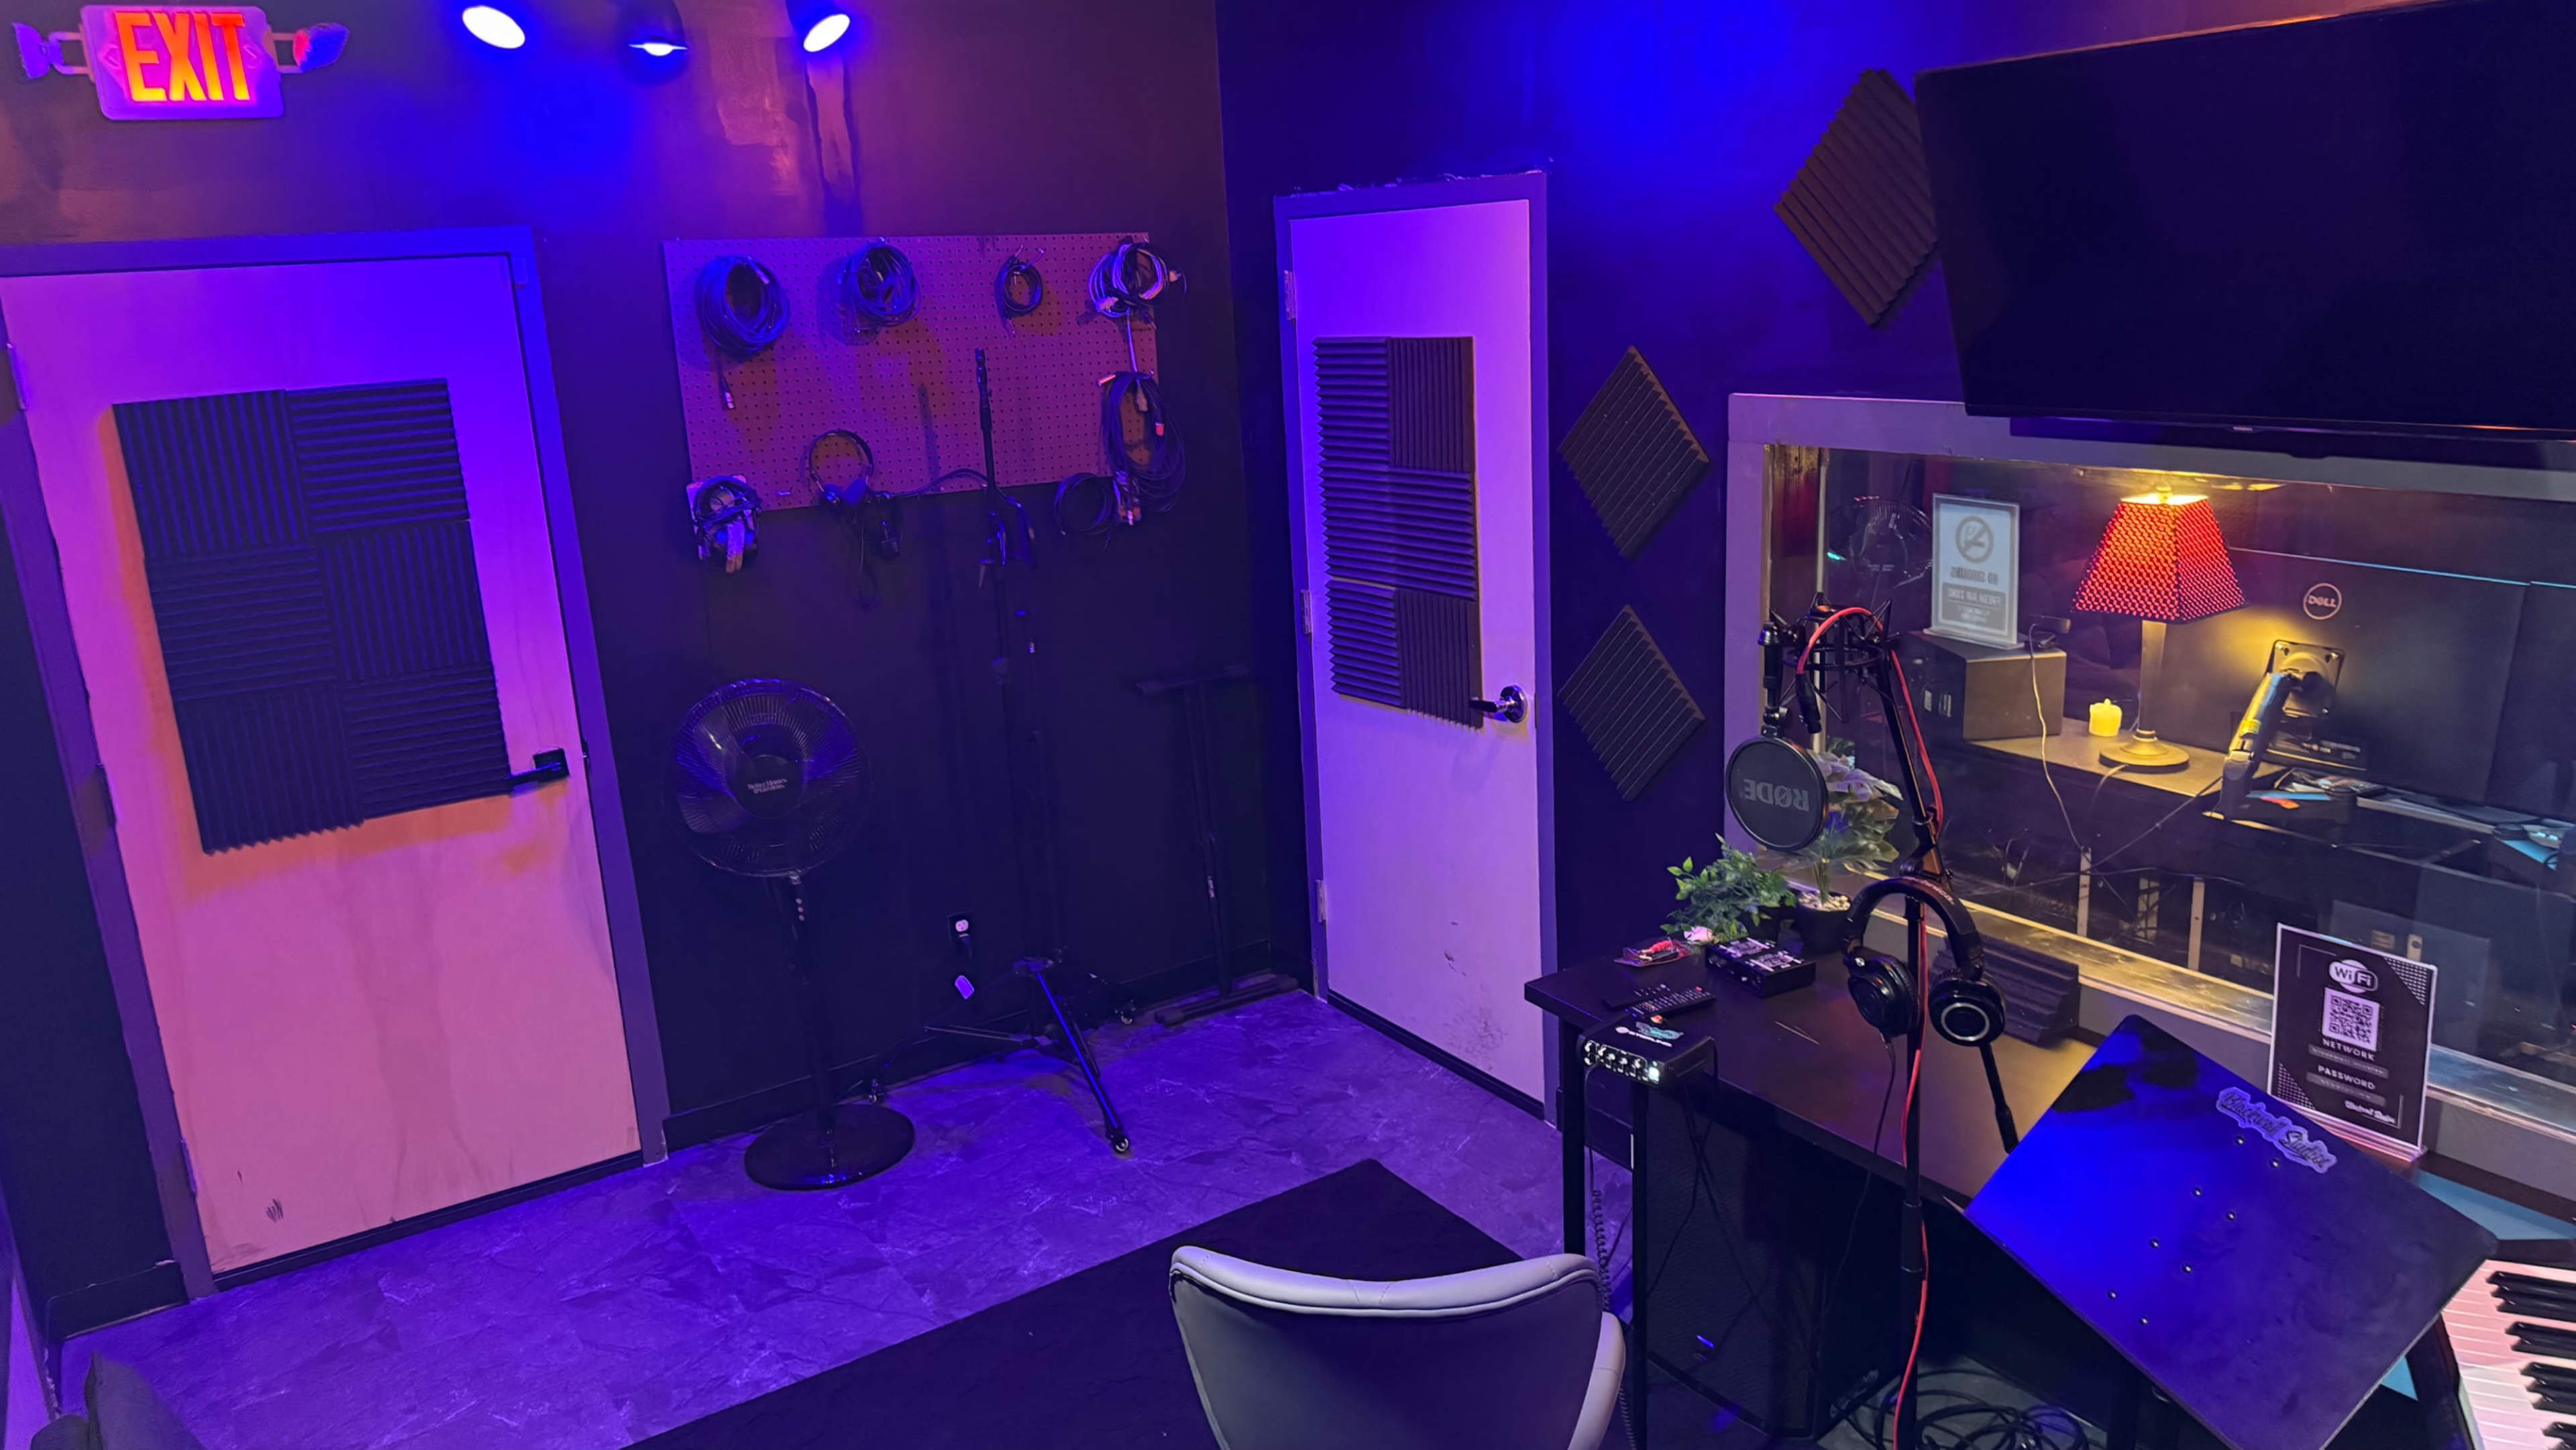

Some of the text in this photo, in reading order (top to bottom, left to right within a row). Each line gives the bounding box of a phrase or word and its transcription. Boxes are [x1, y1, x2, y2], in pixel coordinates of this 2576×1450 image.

[115, 11, 250, 101] EXIT
[2308, 594, 2337, 608] DELL
[1743, 778, 1809, 812] RØDE
[2322, 1037, 2375, 1061] NETWORK
[2318, 1064, 2376, 1090] PASSWORD
